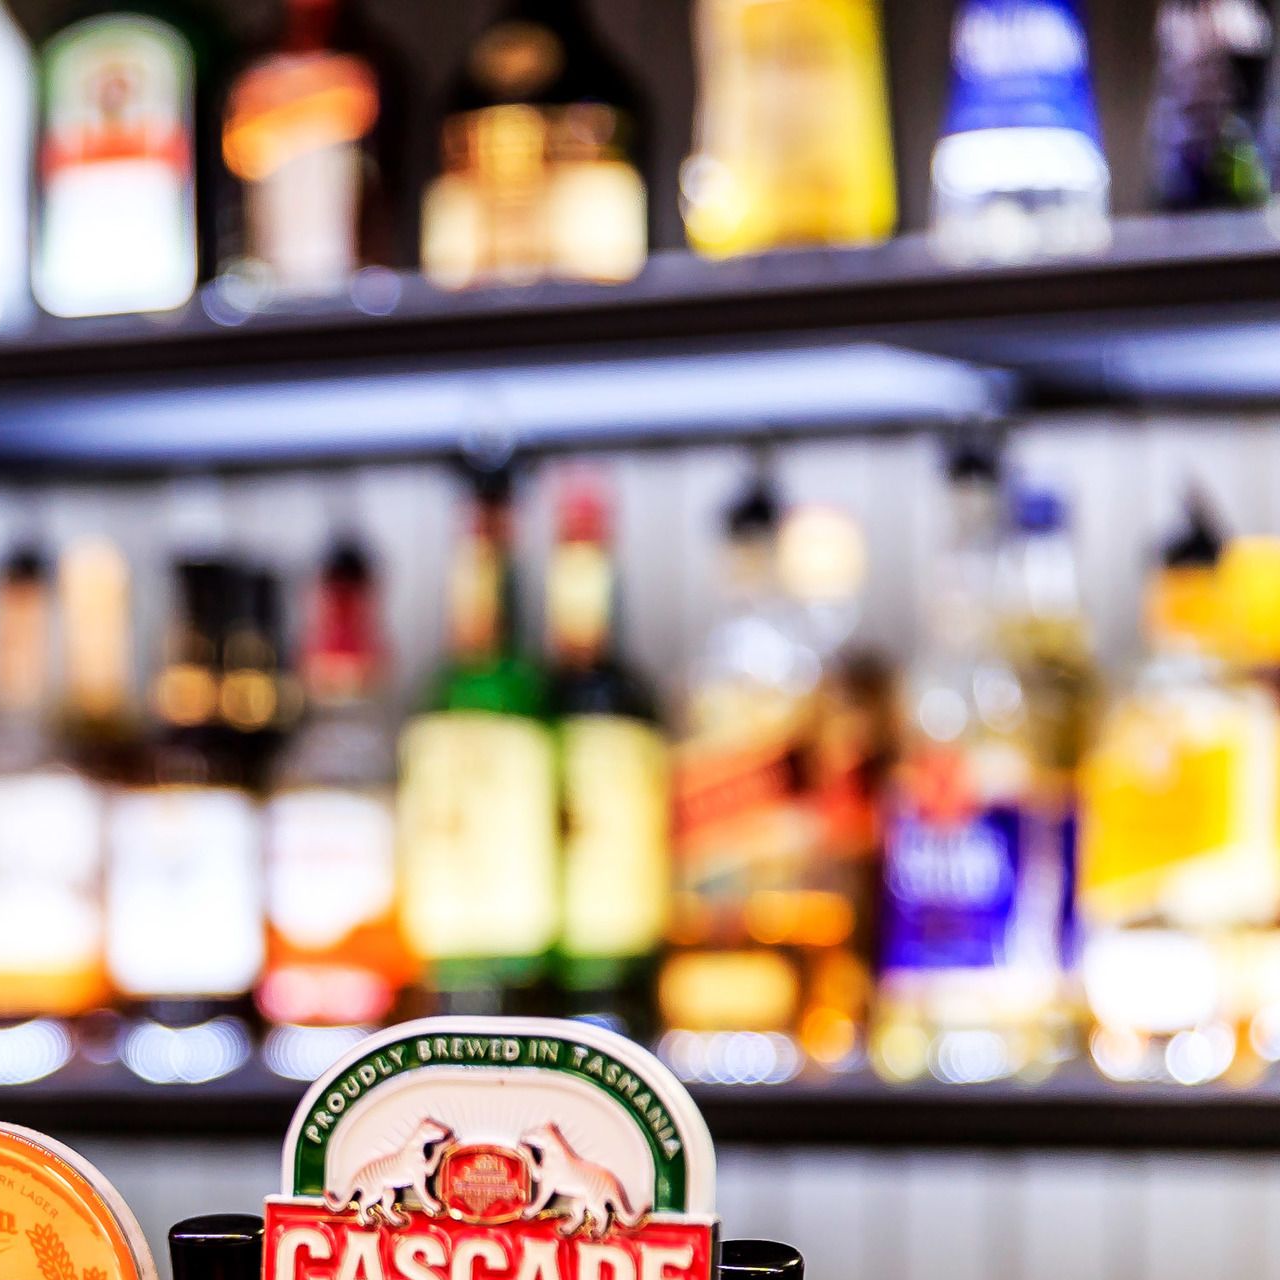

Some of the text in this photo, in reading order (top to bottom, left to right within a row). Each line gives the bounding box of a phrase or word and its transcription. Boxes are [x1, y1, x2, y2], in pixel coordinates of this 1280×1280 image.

[306, 1036, 682, 1161] PROUDLY BREWED IN TASMANIA
[20, 1186, 59, 1219] LAGER
